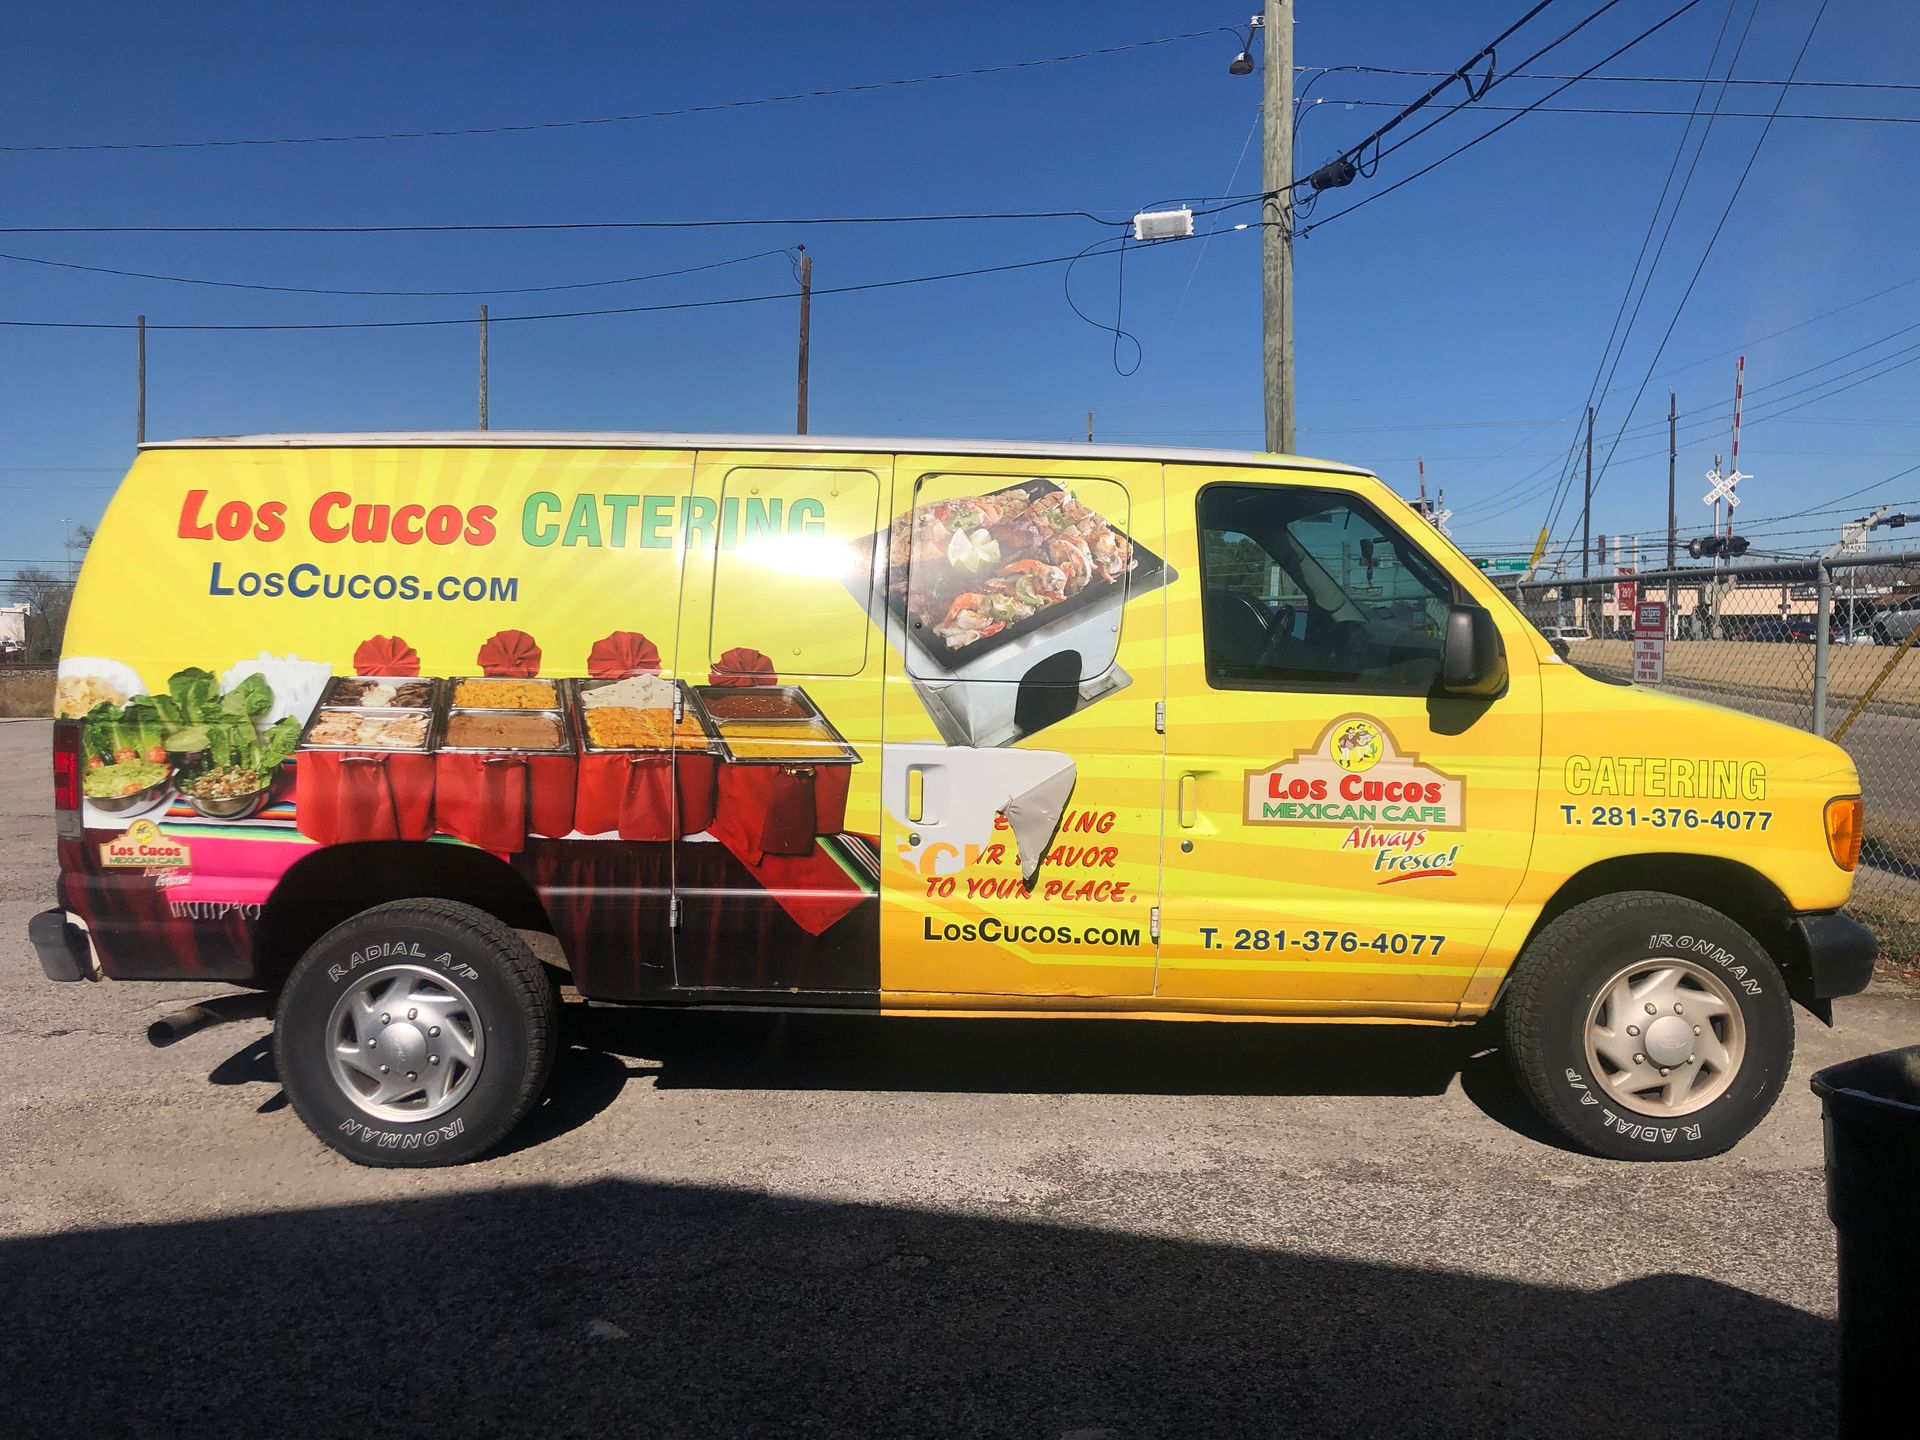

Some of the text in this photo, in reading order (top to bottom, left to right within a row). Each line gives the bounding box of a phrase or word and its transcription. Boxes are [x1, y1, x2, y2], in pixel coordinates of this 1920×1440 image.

[178, 489, 826, 550] Los Cucos CATERING
[1636, 651, 1649, 659] SPOT
[1643, 641, 1655, 650] THIS
[1268, 773, 1442, 803] Los Cucos
[1564, 754, 1766, 801] CATERING
[1263, 802, 1446, 823] MEXICAN CAFE
[1560, 805, 1773, 831] T. 281-376-4077
[110, 844, 182, 856] Los Cucos
[1342, 826, 1428, 852] Always
[1374, 845, 1459, 872] Fresco!
[926, 877, 956, 898] TO
[1044, 879, 1138, 902] PLACE.
[1199, 927, 1446, 956] T. 281-376-4077
[327, 942, 479, 982] RADIAL A/P
[1649, 933, 1762, 997] IRONMAN
[339, 1117, 466, 1149] IRONMAN
[1603, 1107, 1702, 1143] RADIAL
